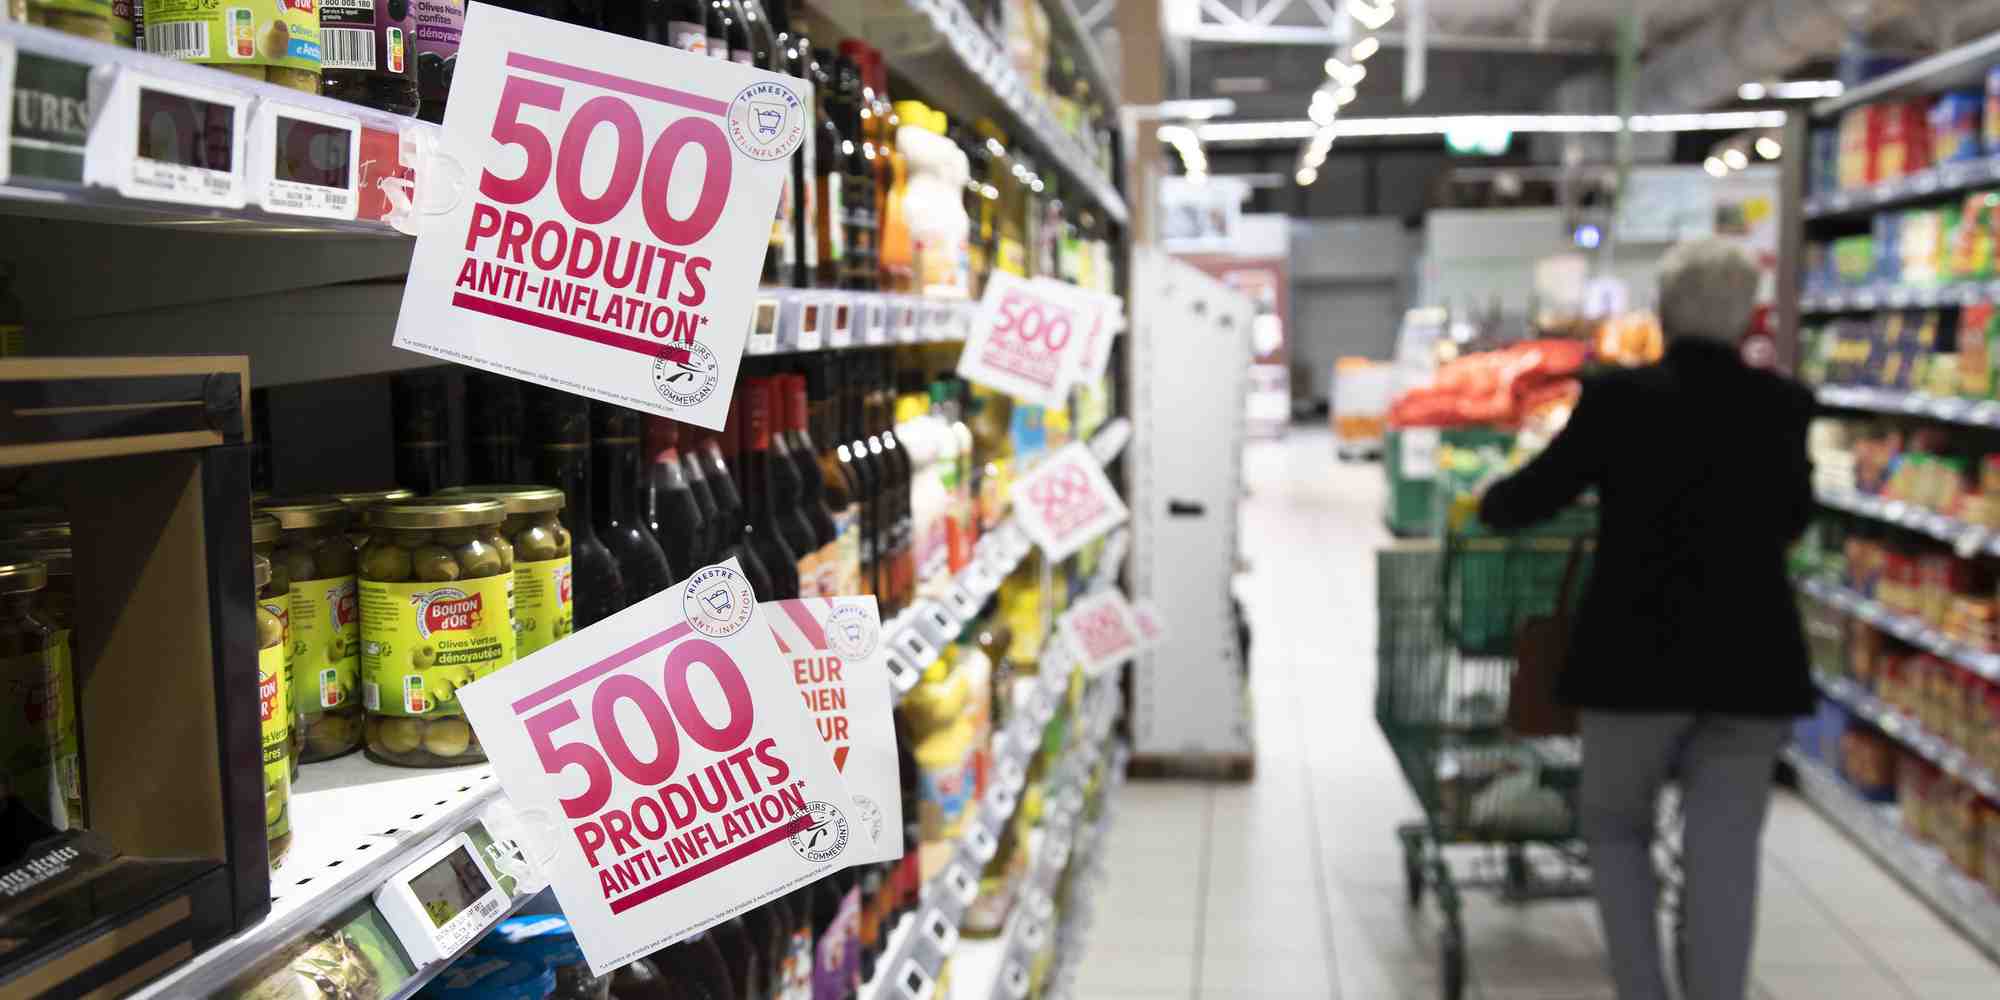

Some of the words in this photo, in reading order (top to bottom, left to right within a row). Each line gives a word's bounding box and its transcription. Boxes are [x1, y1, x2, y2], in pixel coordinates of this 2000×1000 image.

[418, 1, 444, 14] Olives
[418, 14, 451, 24] confites
[740, 85, 798, 109] TRIMESTRE
[731, 119, 801, 157] ANTI-INFLATION
[479, 75, 732, 246] 500
[464, 202, 712, 307] PRODUITS
[992, 293, 1072, 352] 500
[687, 570, 733, 601] TRIMESTRE
[432, 600, 478, 618] BOUTON
[441, 614, 468, 629] d'OR
[690, 589, 750, 634] ANTI-INFLATION
[438, 639, 469, 649] Olives
[438, 647, 501, 664] dénoyautées
[523, 638, 754, 819] 500
[573, 737, 790, 869] PRODUITS
